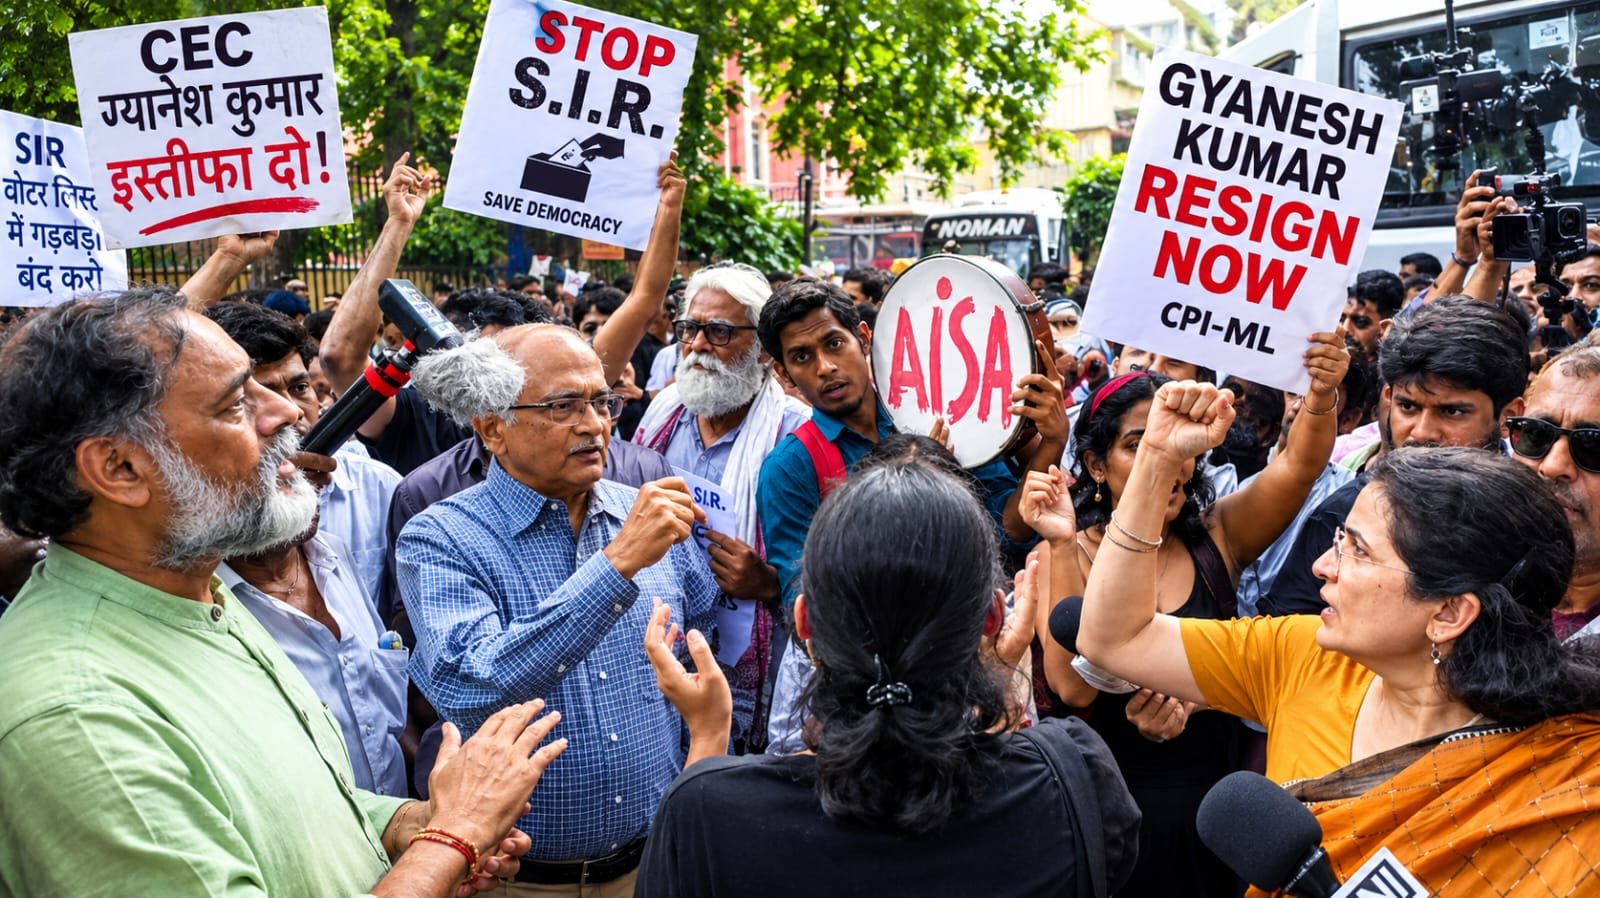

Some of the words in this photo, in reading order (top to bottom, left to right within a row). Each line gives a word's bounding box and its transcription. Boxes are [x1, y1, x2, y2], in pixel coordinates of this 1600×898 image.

[140, 21, 253, 74] CEC
[535, 10, 675, 77] STOP
[98, 75, 213, 131] ग्यानेश
[222, 73, 324, 137] कुमार
[508, 56, 665, 139] S.I.R.
[1159, 62, 1384, 155] GYANESH
[15, 132, 67, 168] SIR
[106, 137, 253, 212] इस्तीफा
[1172, 118, 1347, 200] KUMAR
[2, 170, 48, 208] वोटर
[483, 191, 523, 214] SAVE
[527, 200, 623, 236] DEMOCRACY
[1134, 163, 1361, 266] RESIGN
[6, 212, 24, 248] में
[937, 217, 1026, 239] NOMAN
[16, 256, 54, 294] बंद
[59, 258, 103, 292] करो
[1153, 230, 1308, 312] NOW
[1160, 301, 1277, 355] CPI-ML
